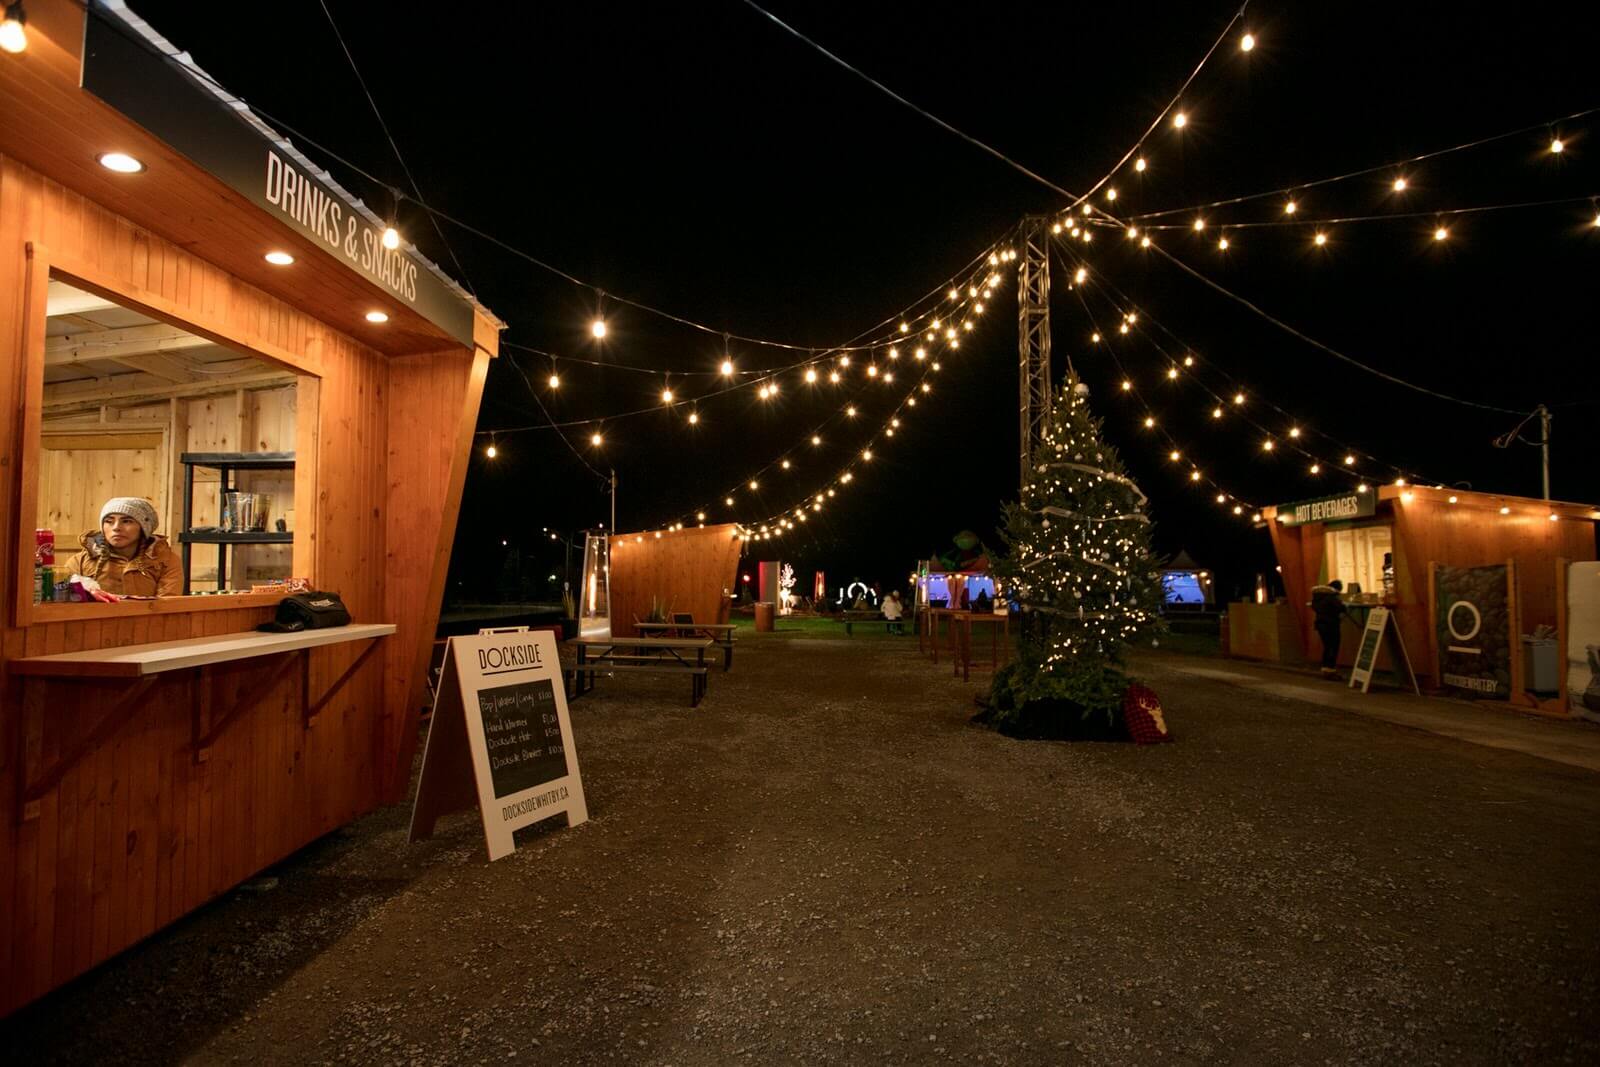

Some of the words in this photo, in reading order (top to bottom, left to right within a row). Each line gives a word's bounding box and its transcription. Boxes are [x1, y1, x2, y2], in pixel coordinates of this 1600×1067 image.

[266, 150, 341, 248] DRINKS
[344, 215, 358, 263] &
[361, 227, 417, 302] SNACKS
[1295, 503, 1311, 523] HOT
[1311, 495, 1358, 521] BEVERAGES
[478, 643, 542, 671] DOCKSIDE
[502, 786, 570, 822] DOCKSIDEWHITBY.CA
